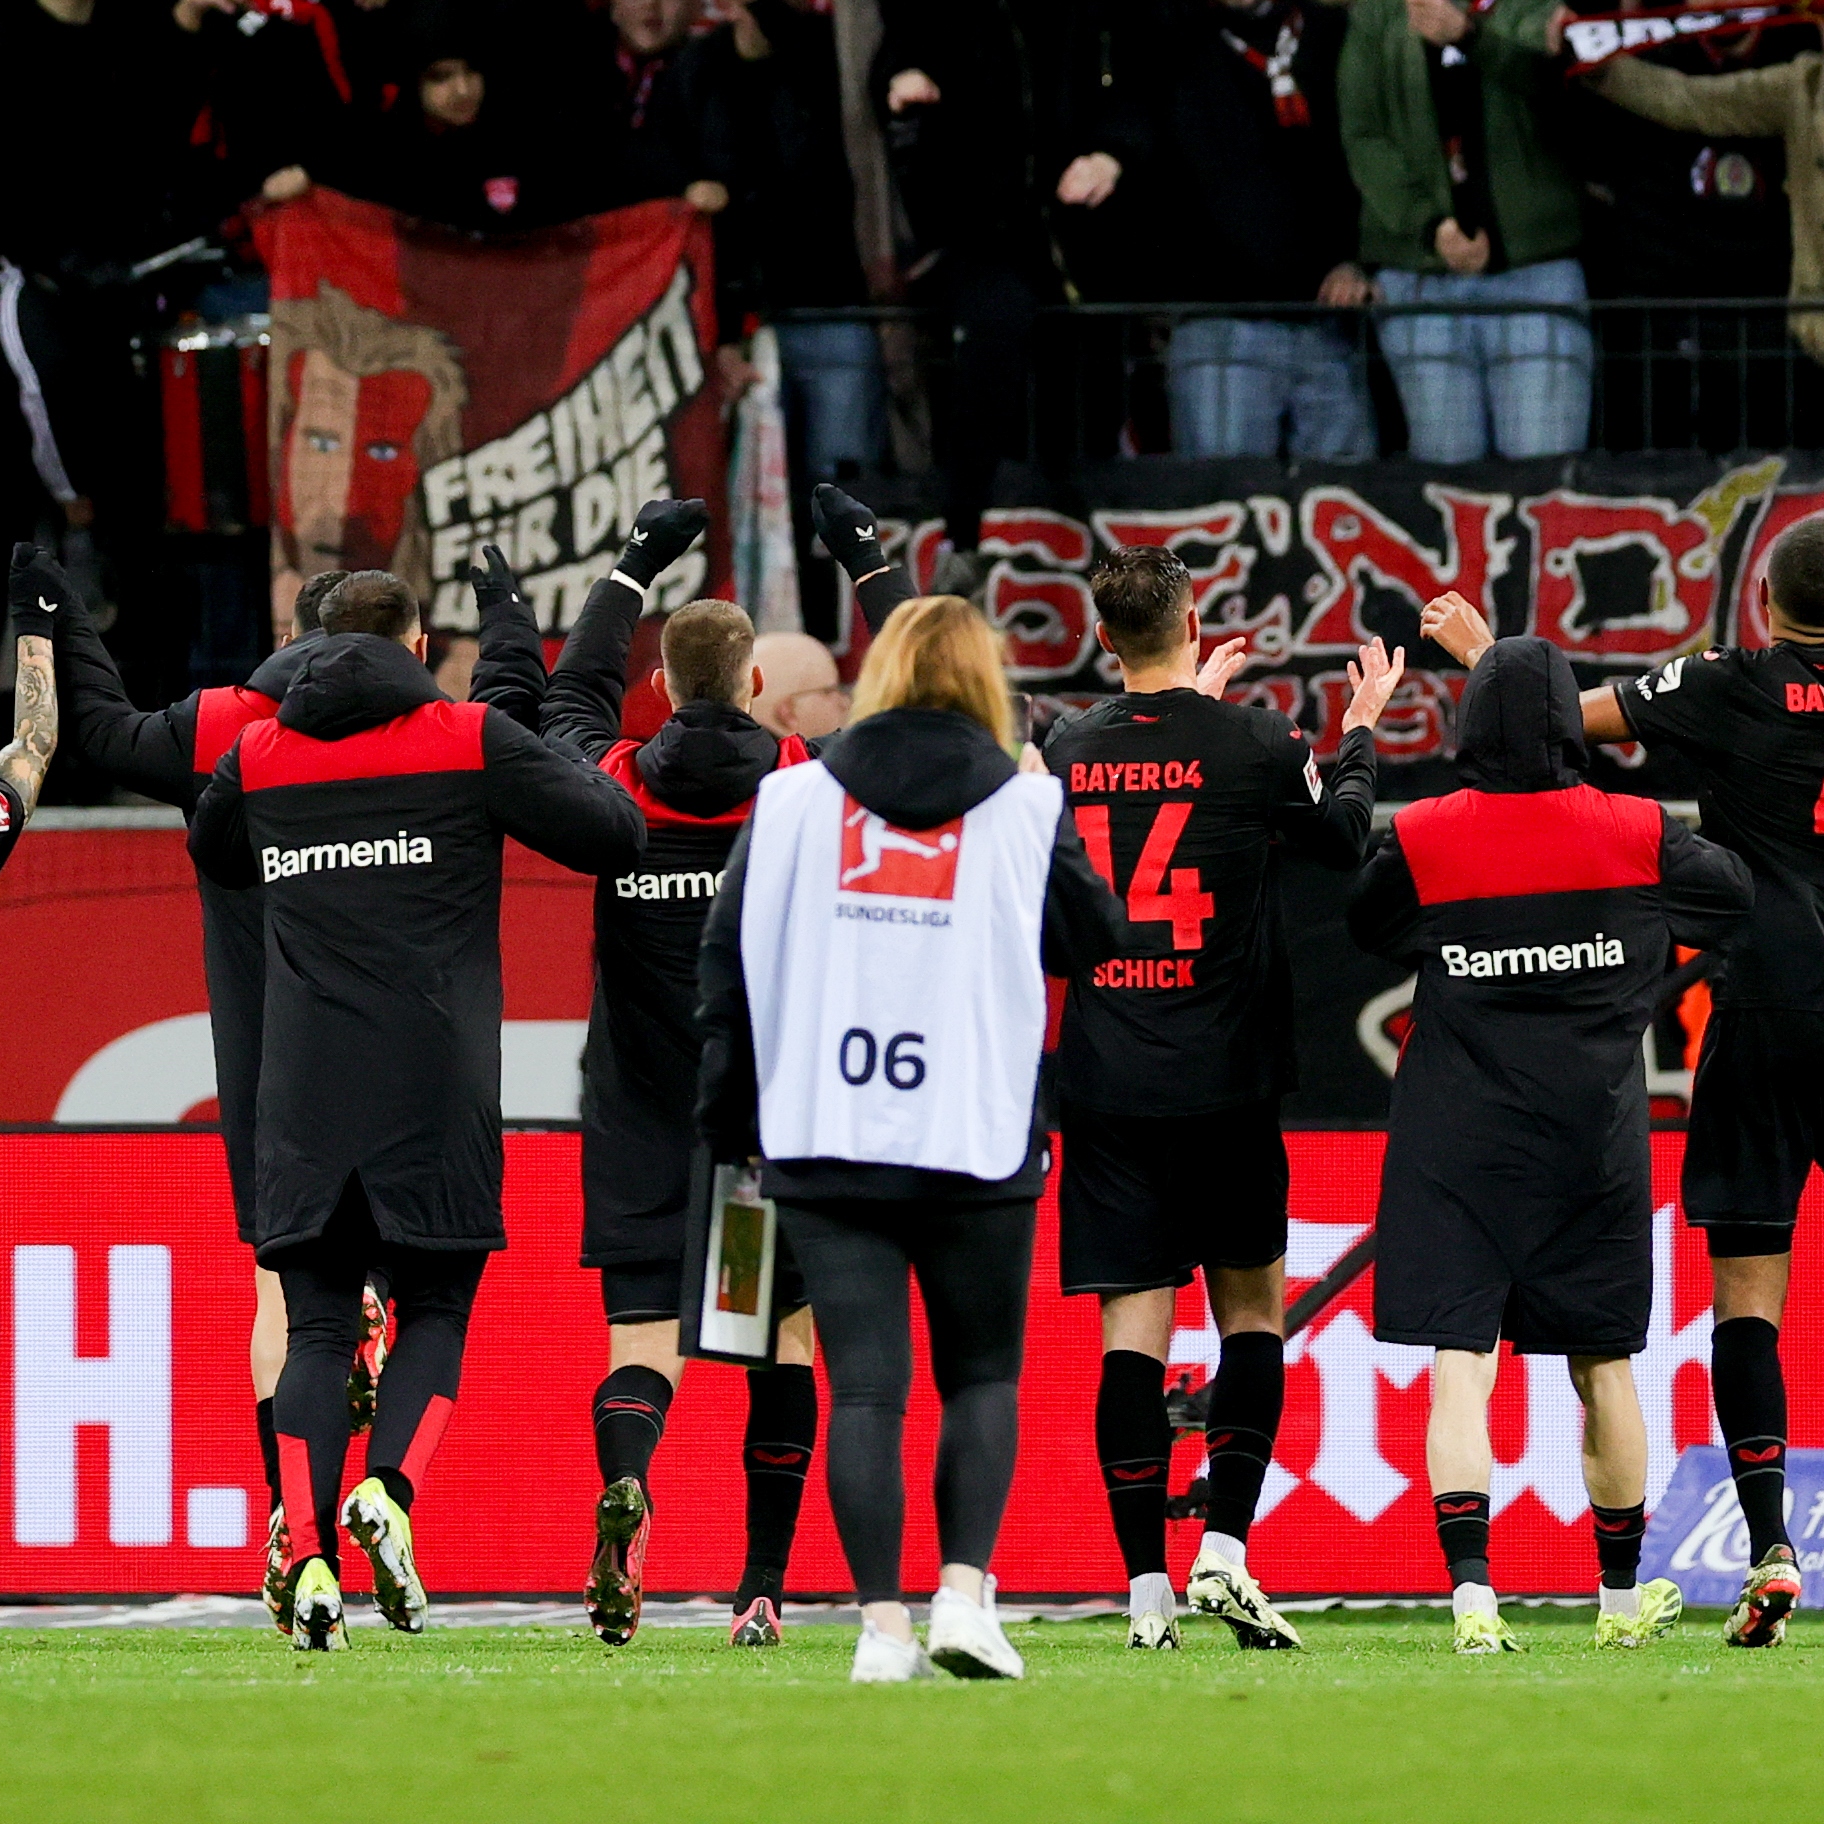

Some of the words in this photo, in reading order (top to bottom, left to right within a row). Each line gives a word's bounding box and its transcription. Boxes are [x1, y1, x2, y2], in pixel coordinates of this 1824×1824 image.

[430, 496, 561, 579] FÜR
[572, 426, 673, 557] DIE
[262, 830, 433, 883] Barmenia
[1073, 802, 1215, 951] 14
[615, 870, 726, 899] Barme
[1093, 958, 1195, 989] SCHICK
[1441, 934, 1624, 979] Barmenia
[839, 1028, 926, 1091] 06
